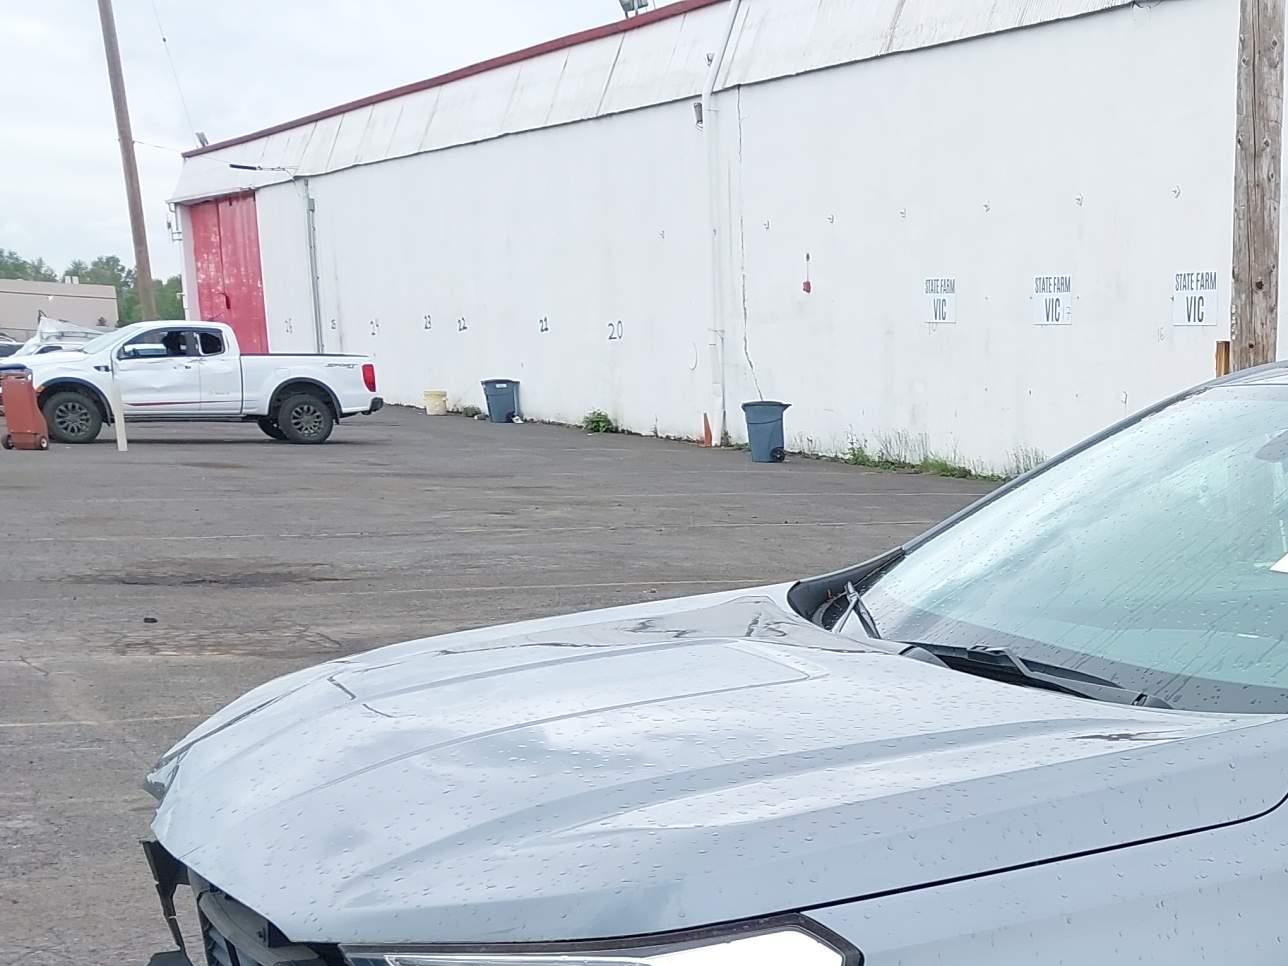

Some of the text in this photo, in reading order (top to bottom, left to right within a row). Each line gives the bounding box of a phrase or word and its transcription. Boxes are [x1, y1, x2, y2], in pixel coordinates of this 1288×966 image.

[925, 278, 955, 294] STATE FARM
[1035, 276, 1071, 293] STATE FARM
[1175, 271, 1217, 291] STATE FARM
[933, 298, 947, 321] VIC
[1045, 297, 1061, 322] VIC
[1186, 295, 1205, 323] VIC
[539, 316, 549, 333] 21
[607, 320, 624, 340] 20
